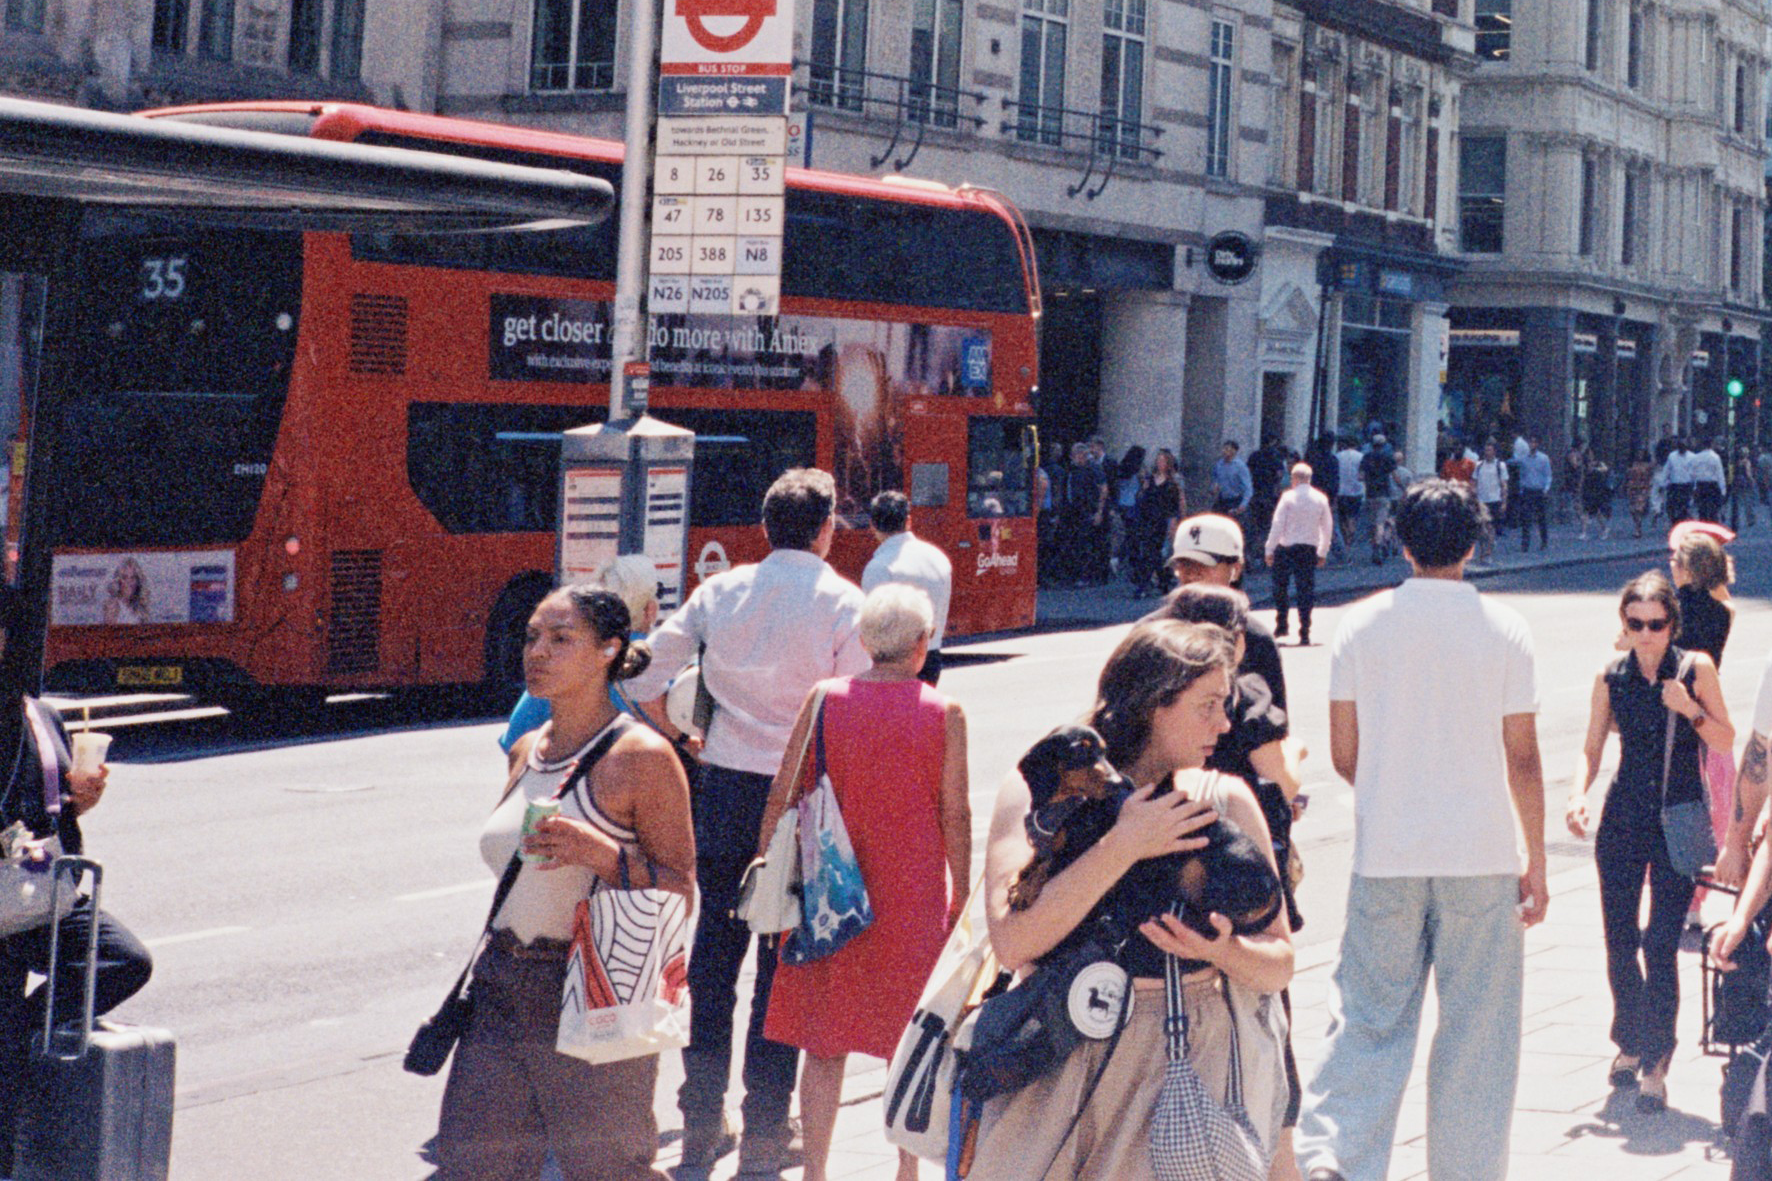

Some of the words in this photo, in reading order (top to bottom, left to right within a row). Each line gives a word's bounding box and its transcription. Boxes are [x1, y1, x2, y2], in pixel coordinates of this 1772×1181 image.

[698, 65, 718, 73] BUS
[721, 65, 747, 73] STOP
[676, 83, 728, 95] Liverpool
[731, 83, 767, 94] Street
[683, 96, 723, 108] Station
[671, 126, 704, 134] towards
[706, 125, 739, 134] Bethnal
[673, 139, 708, 148] Hackney
[721, 139, 737, 147] Old
[740, 139, 766, 147] Street
[670, 167, 679, 181] 8
[707, 168, 726, 182] 26
[751, 167, 770, 181] 35
[664, 209, 682, 222] 47
[706, 208, 724, 222] 78
[745, 208, 771, 222] 135
[658, 247, 683, 261] 205
[699, 247, 726, 261] 388
[745, 248, 768, 262] N8
[142, 259, 187, 299] 35
[653, 286, 683, 301] N26
[691, 287, 729, 301] N205
[503, 314, 537, 347] get
[541, 312, 603, 344] closer
[673, 326, 721, 350] more
[724, 325, 765, 353] with
[769, 328, 819, 356] Amex
